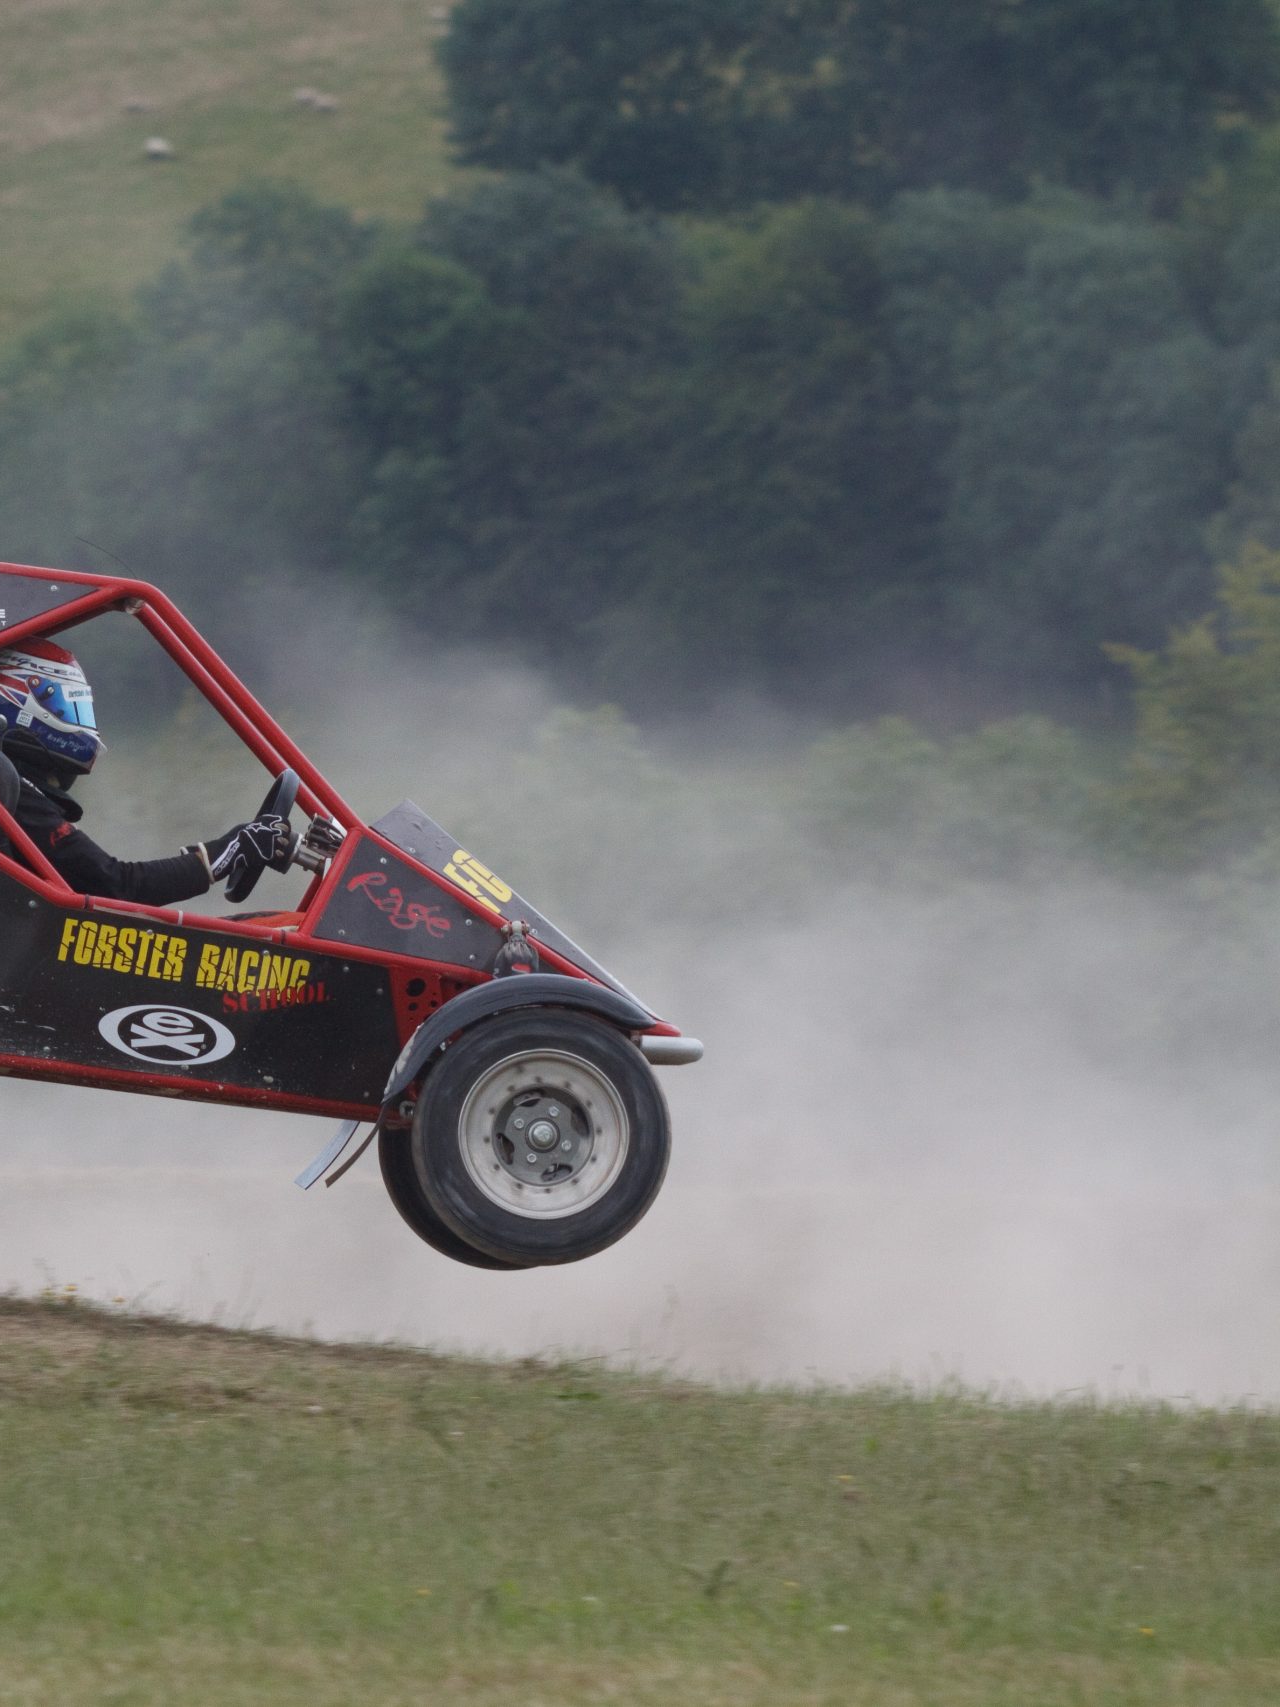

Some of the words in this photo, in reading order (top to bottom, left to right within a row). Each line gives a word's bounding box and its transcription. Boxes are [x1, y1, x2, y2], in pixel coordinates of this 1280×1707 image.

[347, 872, 451, 938] Rage
[58, 918, 188, 983] FORSTER
[196, 943, 311, 1004] RACING
[223, 982, 332, 1014] SCHOOL
